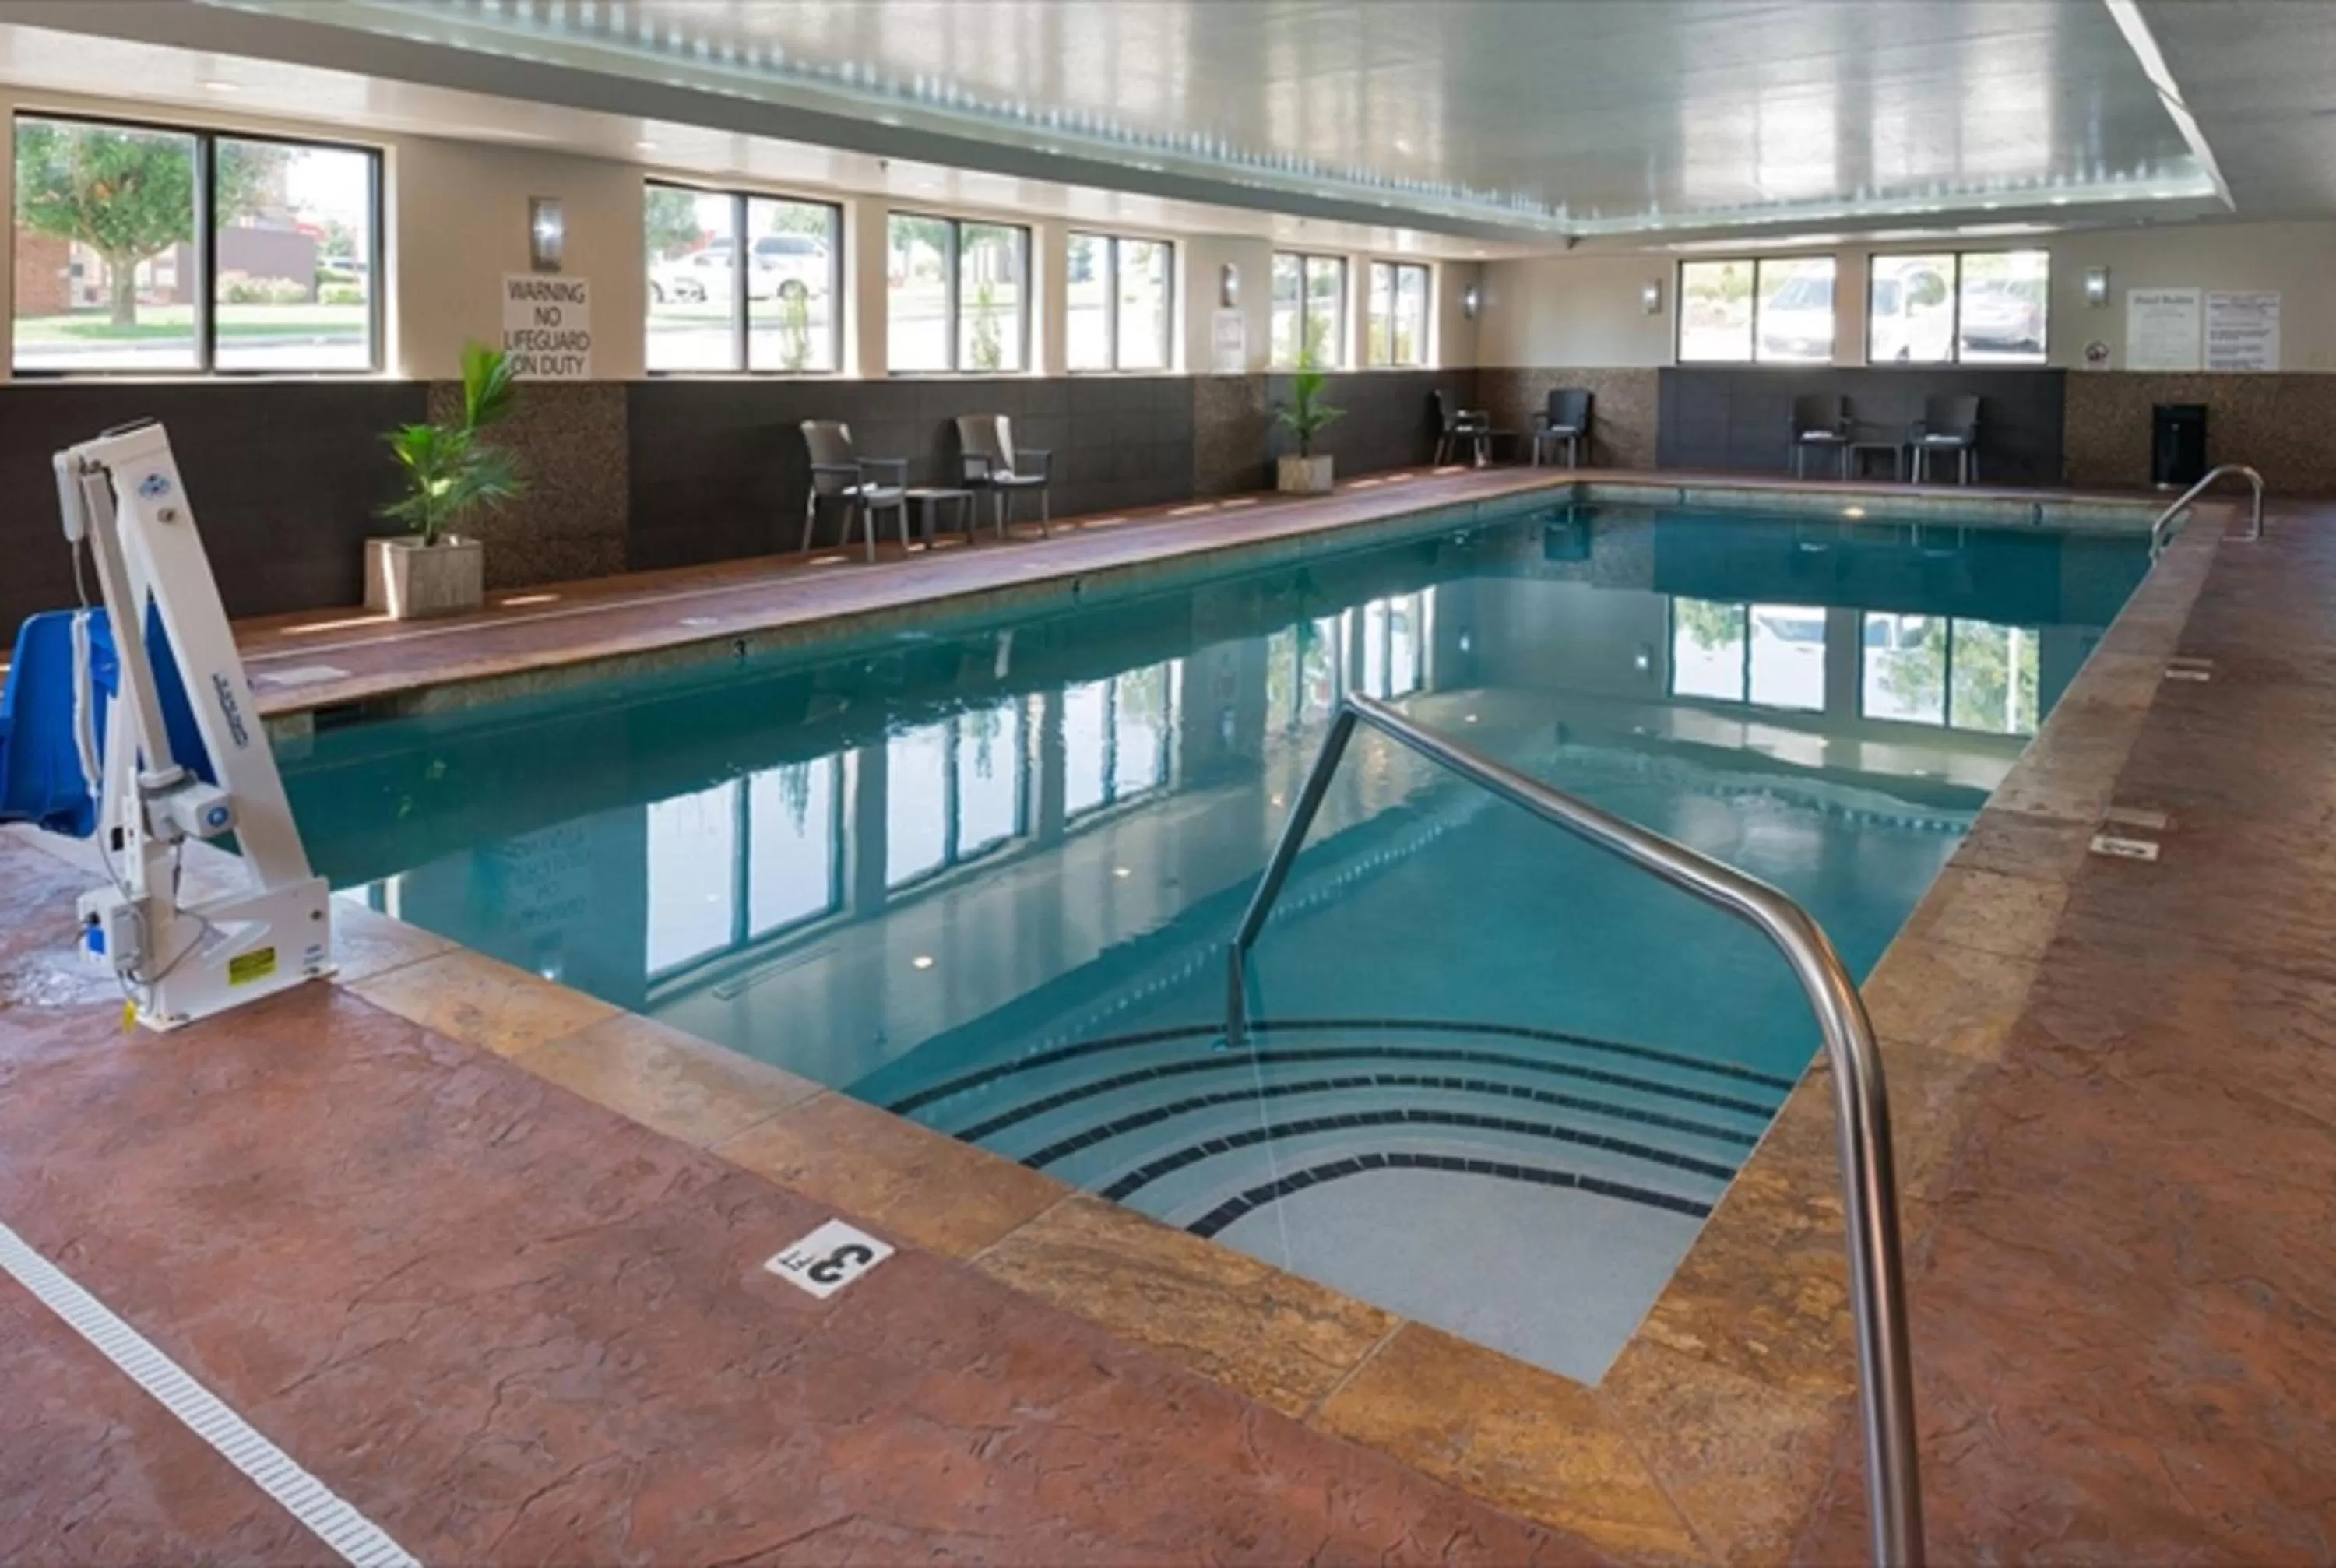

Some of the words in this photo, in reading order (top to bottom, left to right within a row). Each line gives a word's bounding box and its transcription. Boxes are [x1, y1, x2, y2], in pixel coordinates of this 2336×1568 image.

[508, 280, 586, 303] WARNING
[535, 306, 562, 327] NO
[505, 329, 592, 352] LIFEGUARD
[511, 354, 537, 374] ON
[540, 353, 586, 375] DUTY
[808, 1243, 874, 1283] 3
